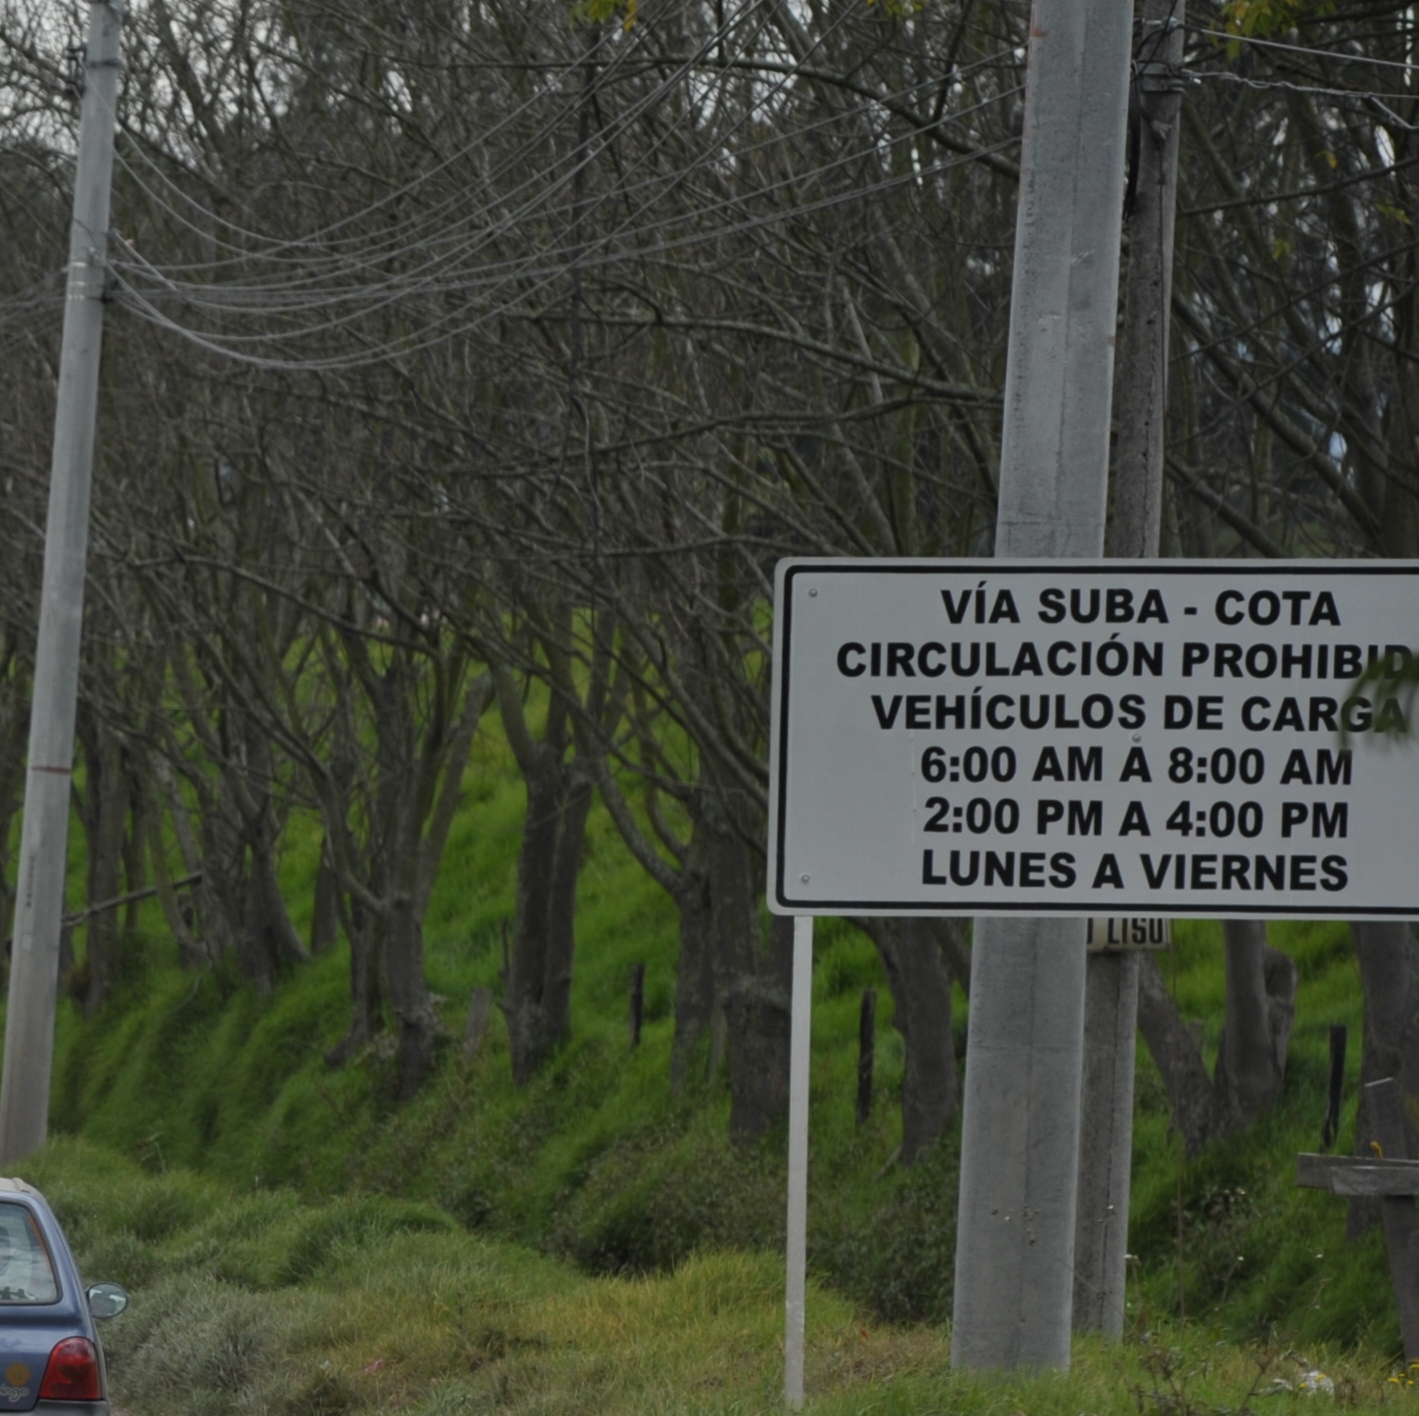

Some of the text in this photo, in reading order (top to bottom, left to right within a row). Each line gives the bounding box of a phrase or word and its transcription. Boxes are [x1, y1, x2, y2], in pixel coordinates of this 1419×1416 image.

[940, 580, 1021, 625] VÍA
[1037, 588, 1169, 625] SUBA
[1214, 589, 1341, 627] COTA
[836, 632, 1419, 680] CIRCULACIÓN PROHIBID
[870, 687, 1409, 733] VEHÍCULOS DE CARGA
[921, 746, 1353, 786] 6:00 AM A 8:00 AM
[923, 796, 1348, 839] 2:00 PM A 4:00 PM
[922, 849, 1349, 892] LUNES A VIERNES
